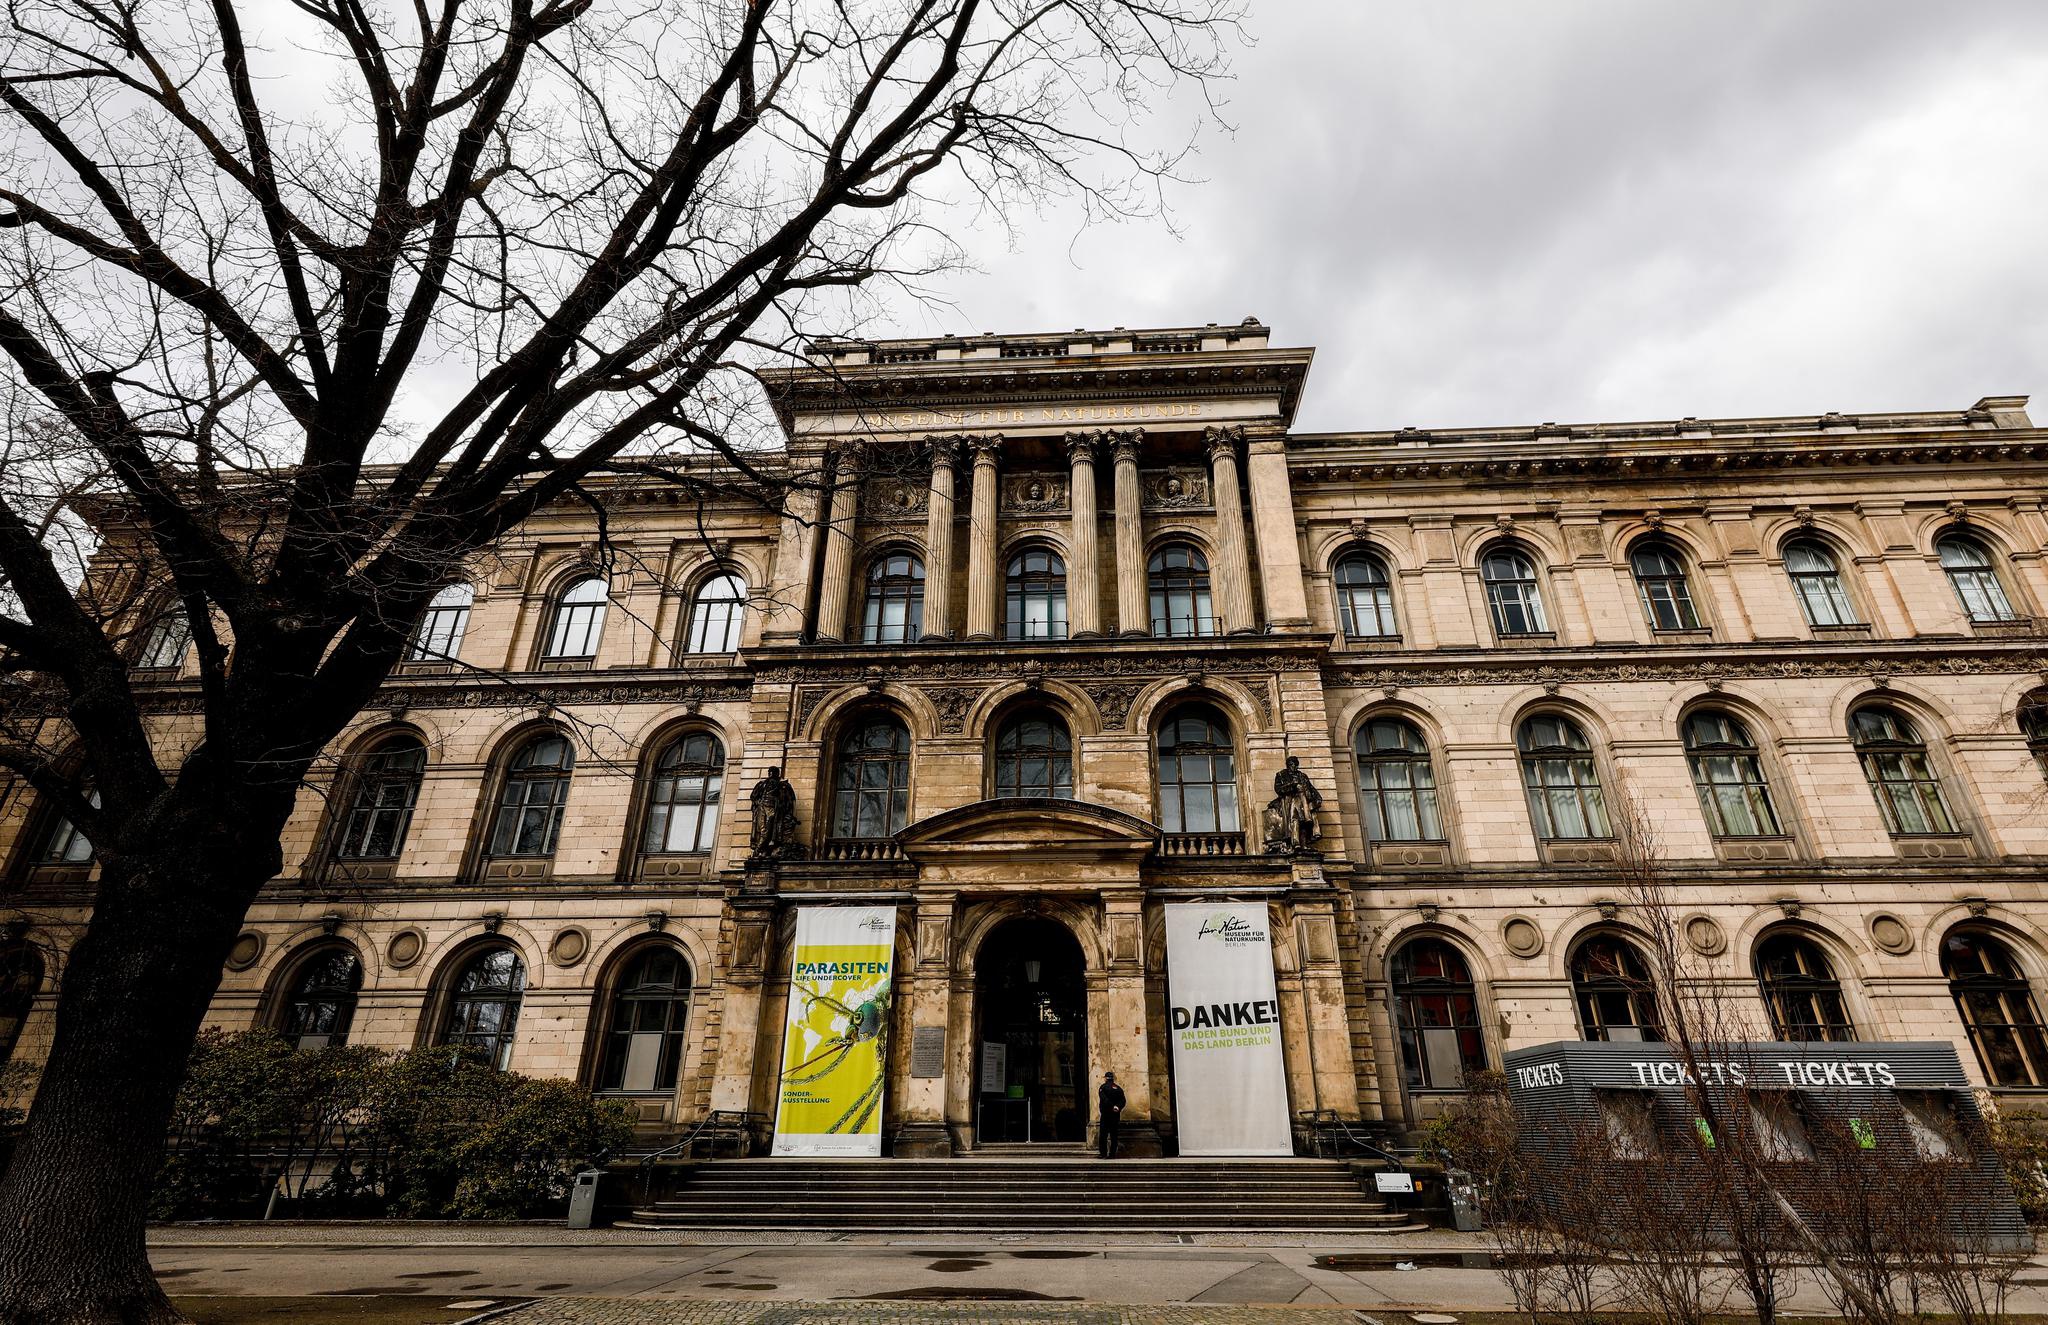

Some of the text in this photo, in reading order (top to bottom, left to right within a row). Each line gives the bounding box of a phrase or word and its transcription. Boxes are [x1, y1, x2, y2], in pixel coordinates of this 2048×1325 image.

[868, 404, 1202, 426] MUSEUM FÜR NATURKUNDE
[1218, 916, 1251, 935] Natur
[796, 962, 889, 974] PARASITEN
[1172, 1001, 1278, 1030] DANKE!
[1181, 1025, 1271, 1041] AN DEN BUND UND
[1184, 1034, 1271, 1050] DAS LAND BERLIN
[1516, 1062, 1563, 1089] TICKETS
[1778, 1062, 1896, 1086] TICKETS
